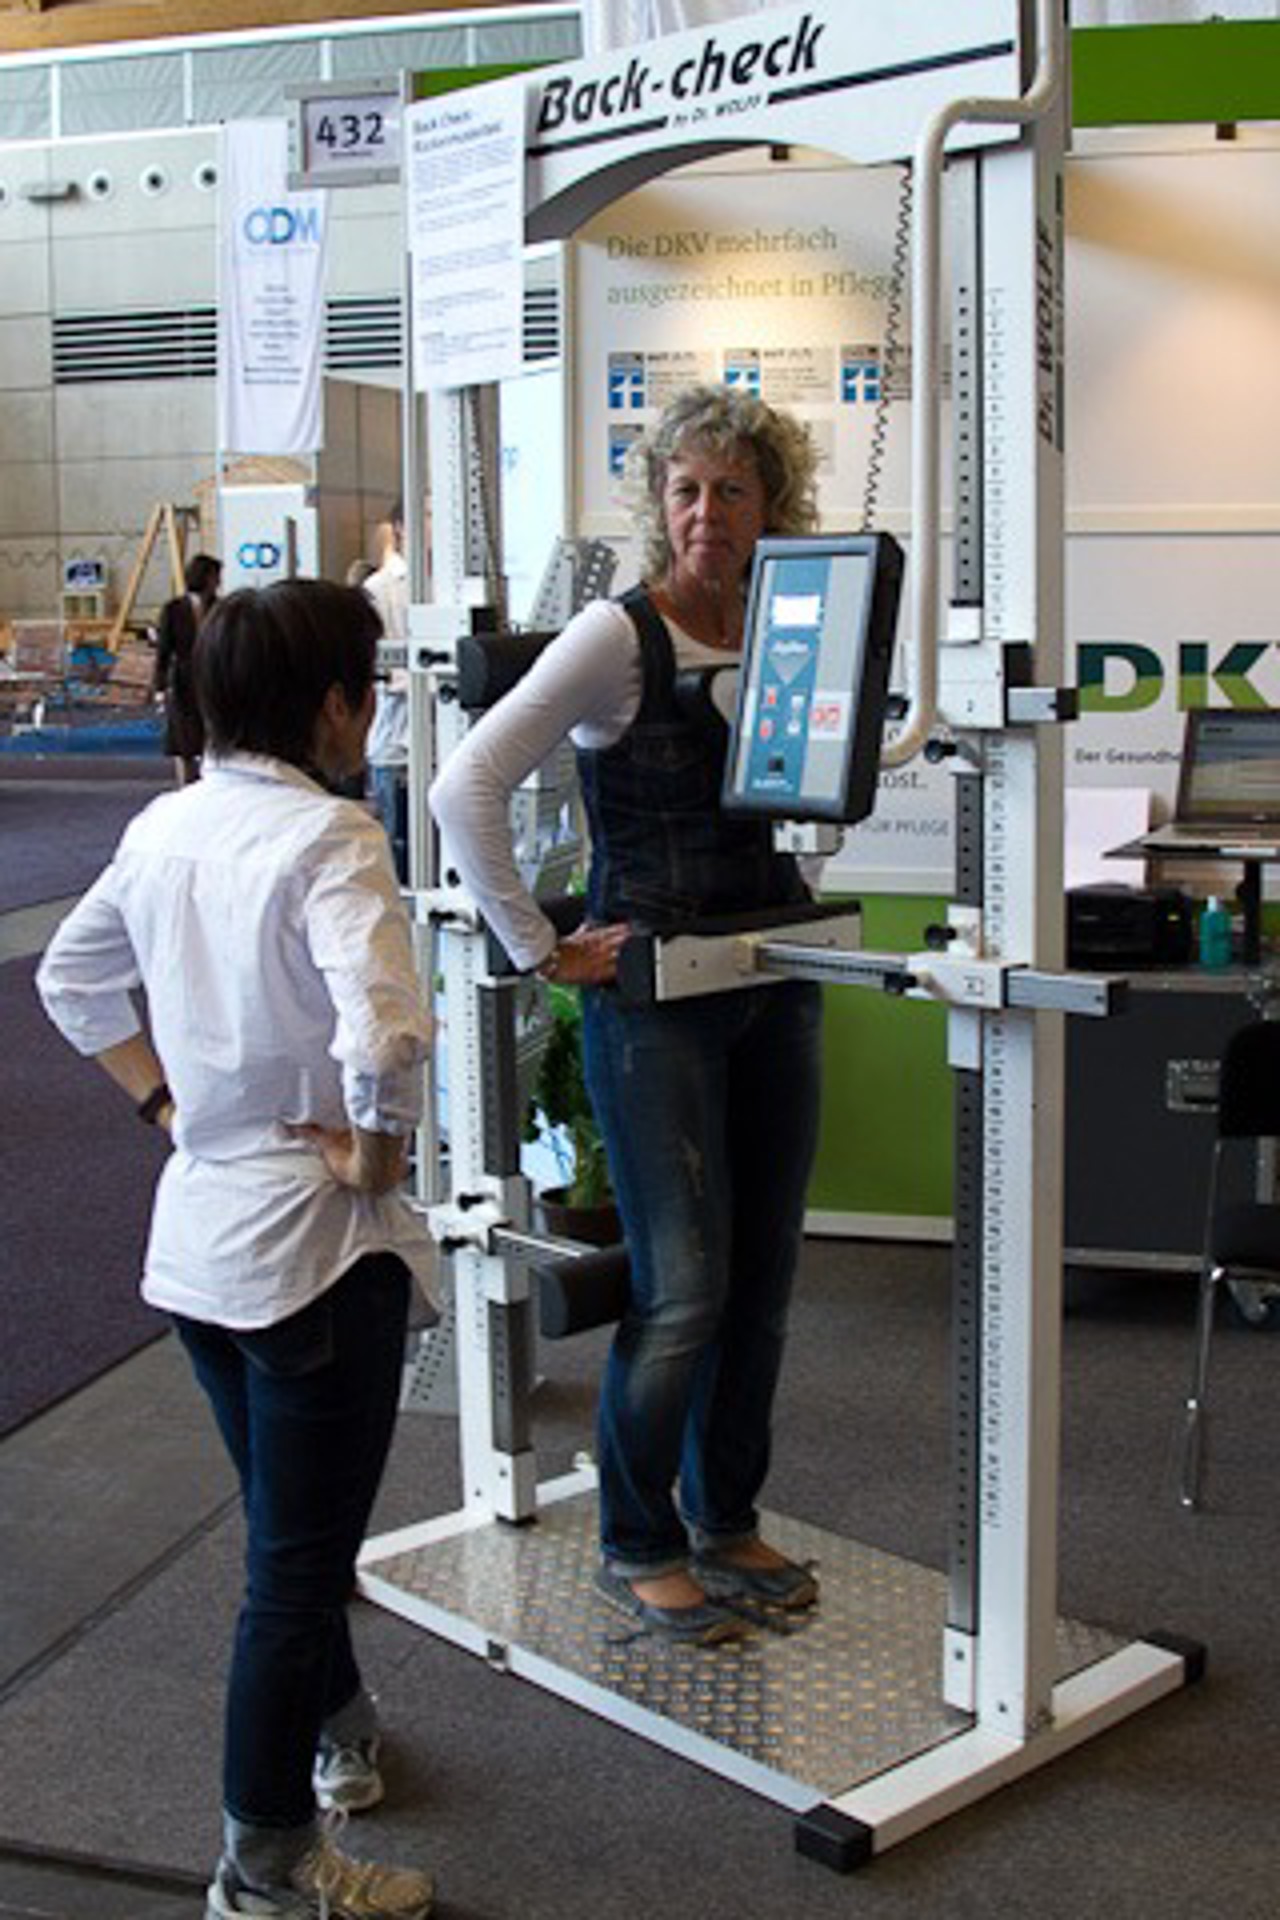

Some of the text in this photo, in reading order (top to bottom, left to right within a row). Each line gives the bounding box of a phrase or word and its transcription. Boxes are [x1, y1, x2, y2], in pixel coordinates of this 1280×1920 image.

[537, 15, 824, 132] Back-check
[315, 112, 385, 148] 432
[606, 225, 838, 258] Die DKV mehrfach
[607, 275, 783, 308] ausgezeichnet
[791, 275, 812, 298] in
[1077, 642, 1280, 712] DK
